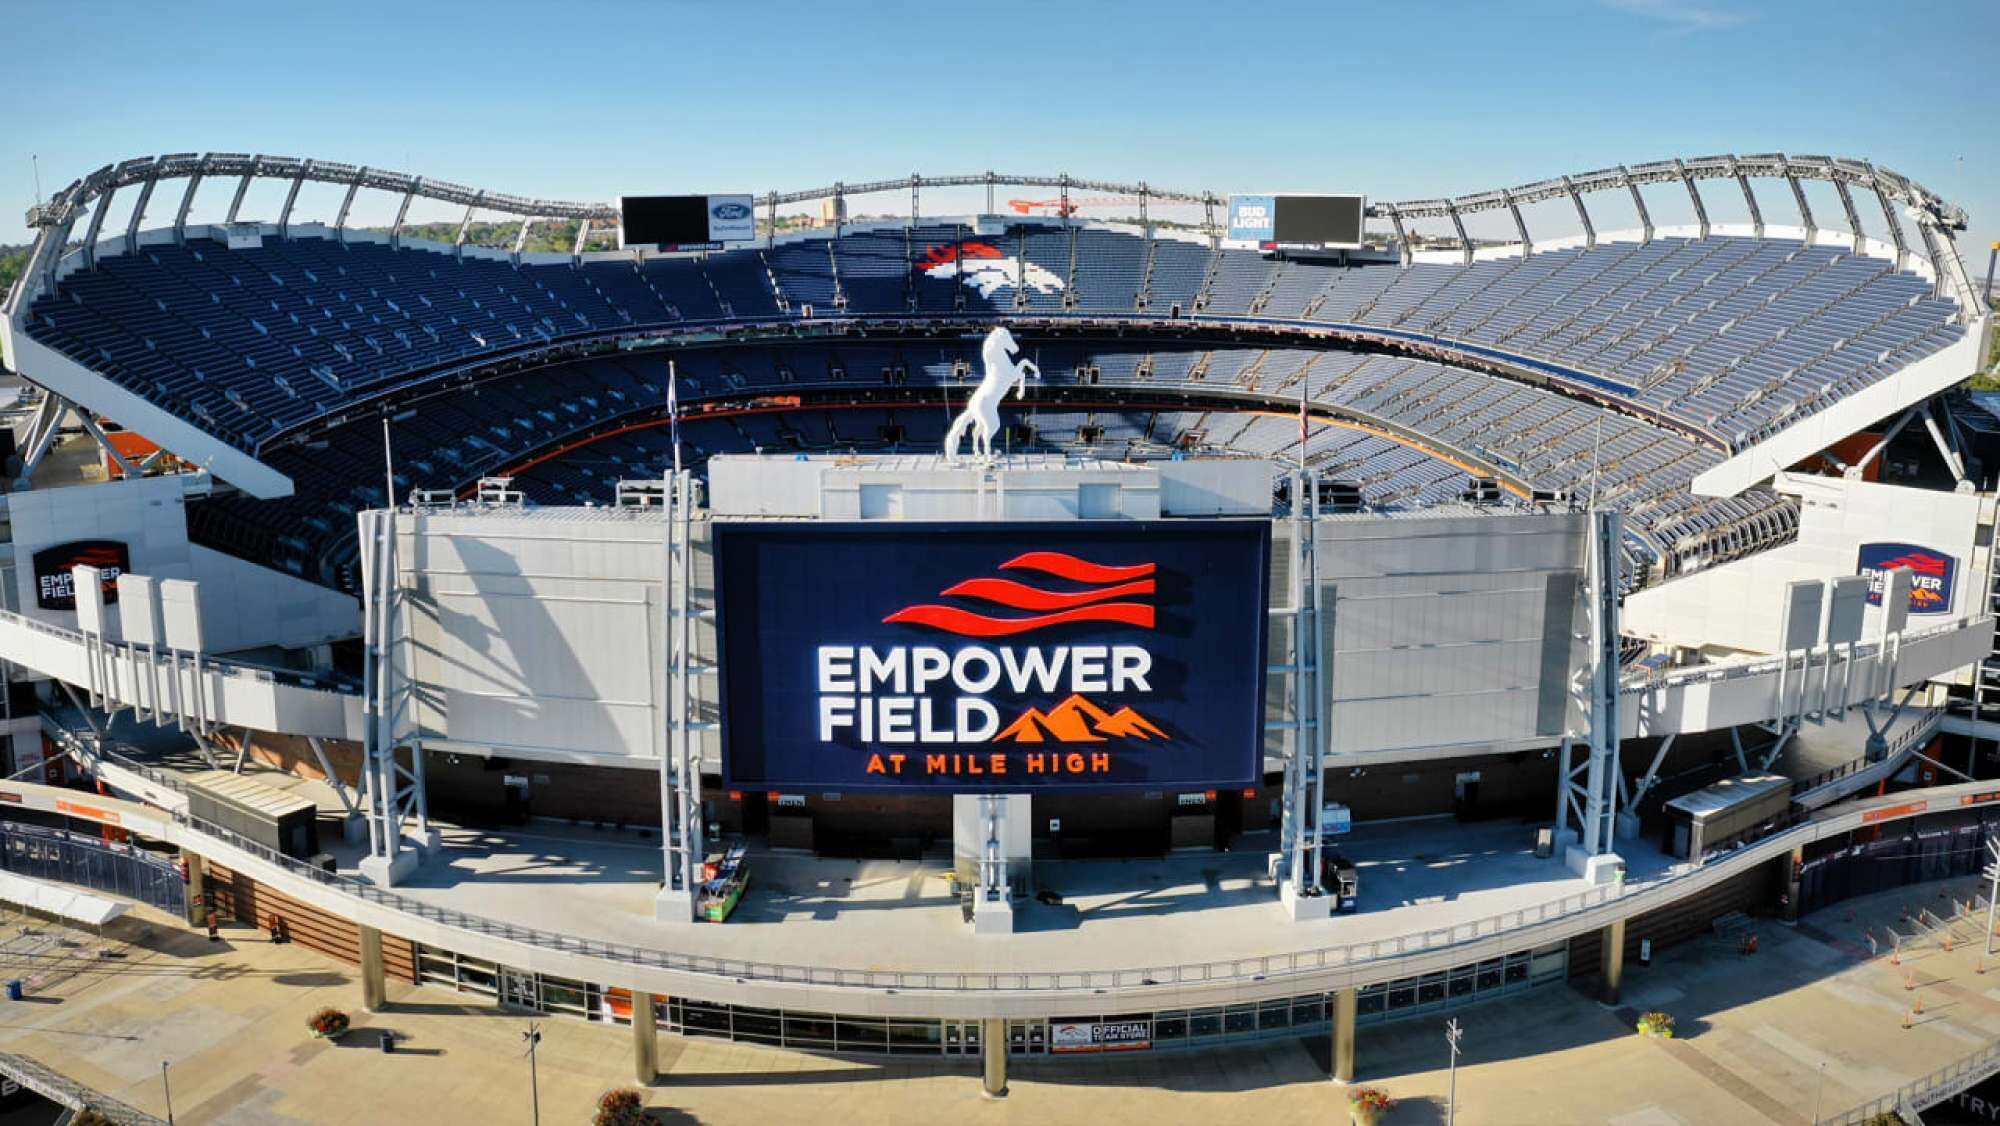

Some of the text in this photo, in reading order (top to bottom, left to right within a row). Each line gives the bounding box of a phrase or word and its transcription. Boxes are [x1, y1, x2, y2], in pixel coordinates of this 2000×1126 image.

[719, 204, 745, 219] Ford
[1238, 206, 1265, 217] BUD
[1233, 217, 1269, 229] LIGHT
[40, 567, 120, 588] EMPER
[41, 585, 77, 600] FIEL
[818, 645, 1152, 694] EMPOWER
[819, 696, 1000, 743] FIELD
[866, 752, 1110, 774] AT MILE HIGH
[1093, 1024, 1145, 1034] OFFICIAL
